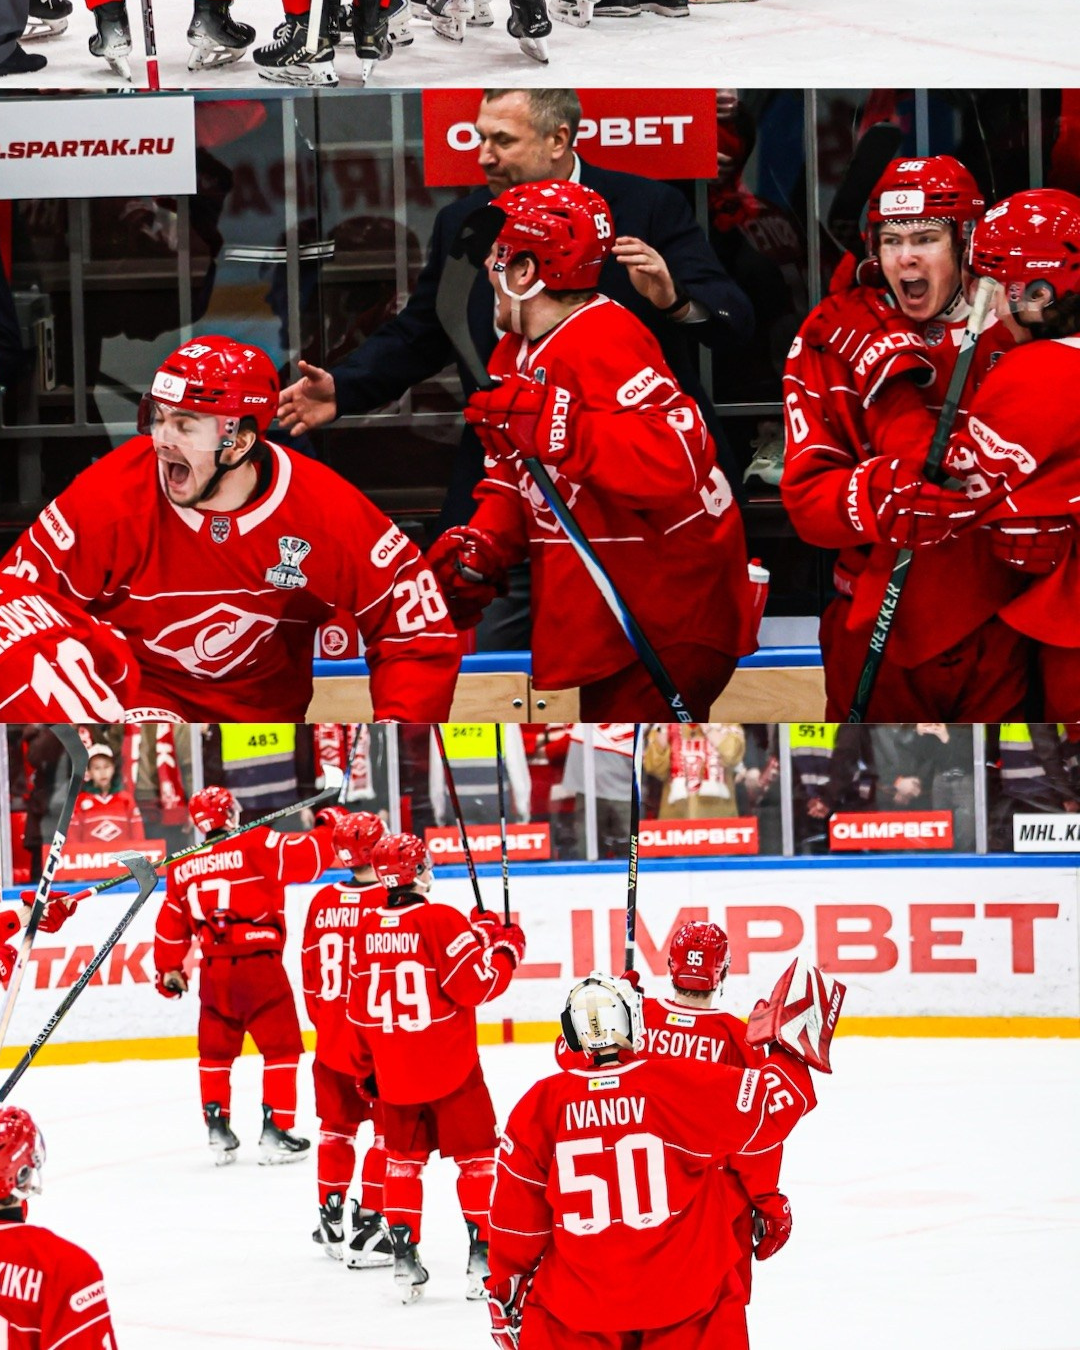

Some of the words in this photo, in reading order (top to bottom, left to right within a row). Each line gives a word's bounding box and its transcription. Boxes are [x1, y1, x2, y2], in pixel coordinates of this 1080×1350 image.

[896, 160, 926, 173] 96
[883, 205, 921, 214] OLIMPBET
[593, 213, 612, 240] 95
[1026, 260, 1062, 269] CCM
[178, 343, 212, 359] 28
[243, 395, 268, 404] CCM
[972, 424, 1030, 468] OLIMPBET
[393, 569, 449, 633] 28
[870, 581, 901, 653] REKKER
[247, 733, 279, 748] 483
[640, 826, 755, 849] OLIMPBET
[833, 818, 950, 840] OLIMPBET
[366, 932, 420, 955] DRONOV
[686, 950, 704, 967] 95
[366, 960, 432, 1034] 49
[565, 1096, 646, 1132] IVANOV
[556, 1133, 672, 1237] 50
